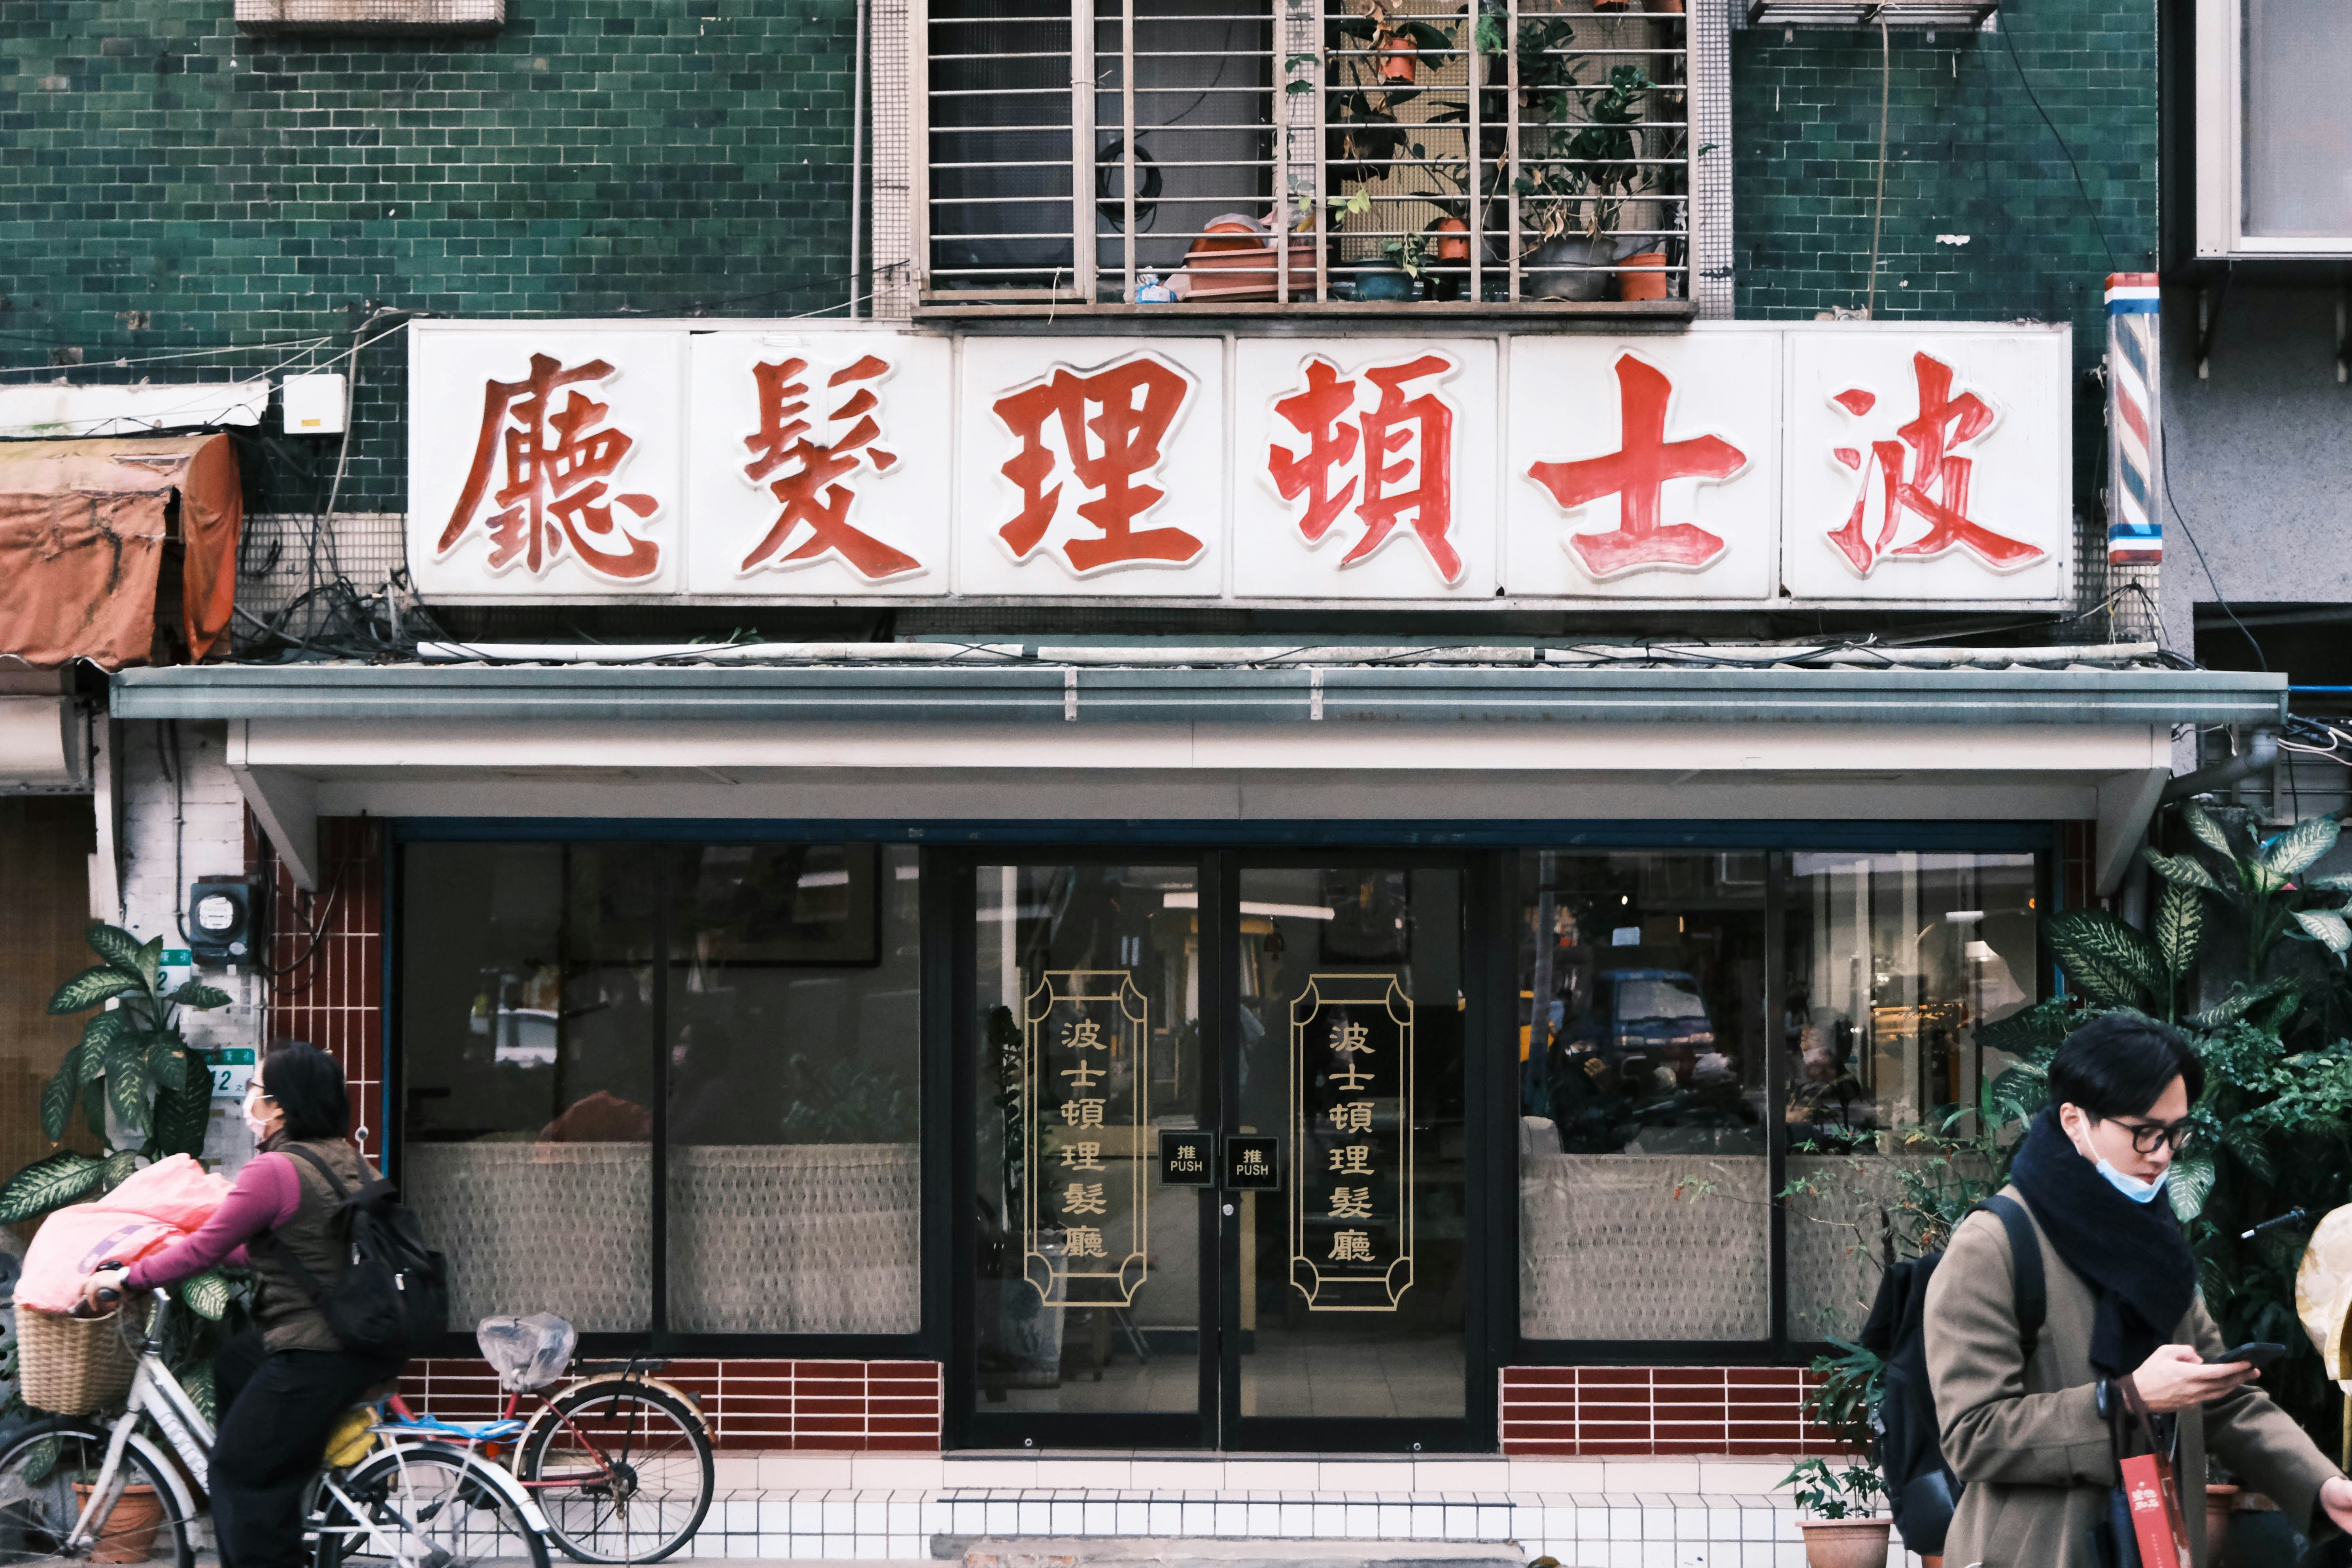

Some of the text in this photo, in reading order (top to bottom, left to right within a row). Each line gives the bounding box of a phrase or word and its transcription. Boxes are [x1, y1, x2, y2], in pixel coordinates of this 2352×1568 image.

[1060, 1018, 1108, 1258] 波士頓理髮廳
[1328, 1022, 1375, 1262] 波士頓理髮廳
[1177, 1145, 1196, 1159] 推
[1243, 1149, 1262, 1163] 推
[1170, 1160, 1202, 1172] PUSH
[1236, 1164, 1268, 1176] PUSH
